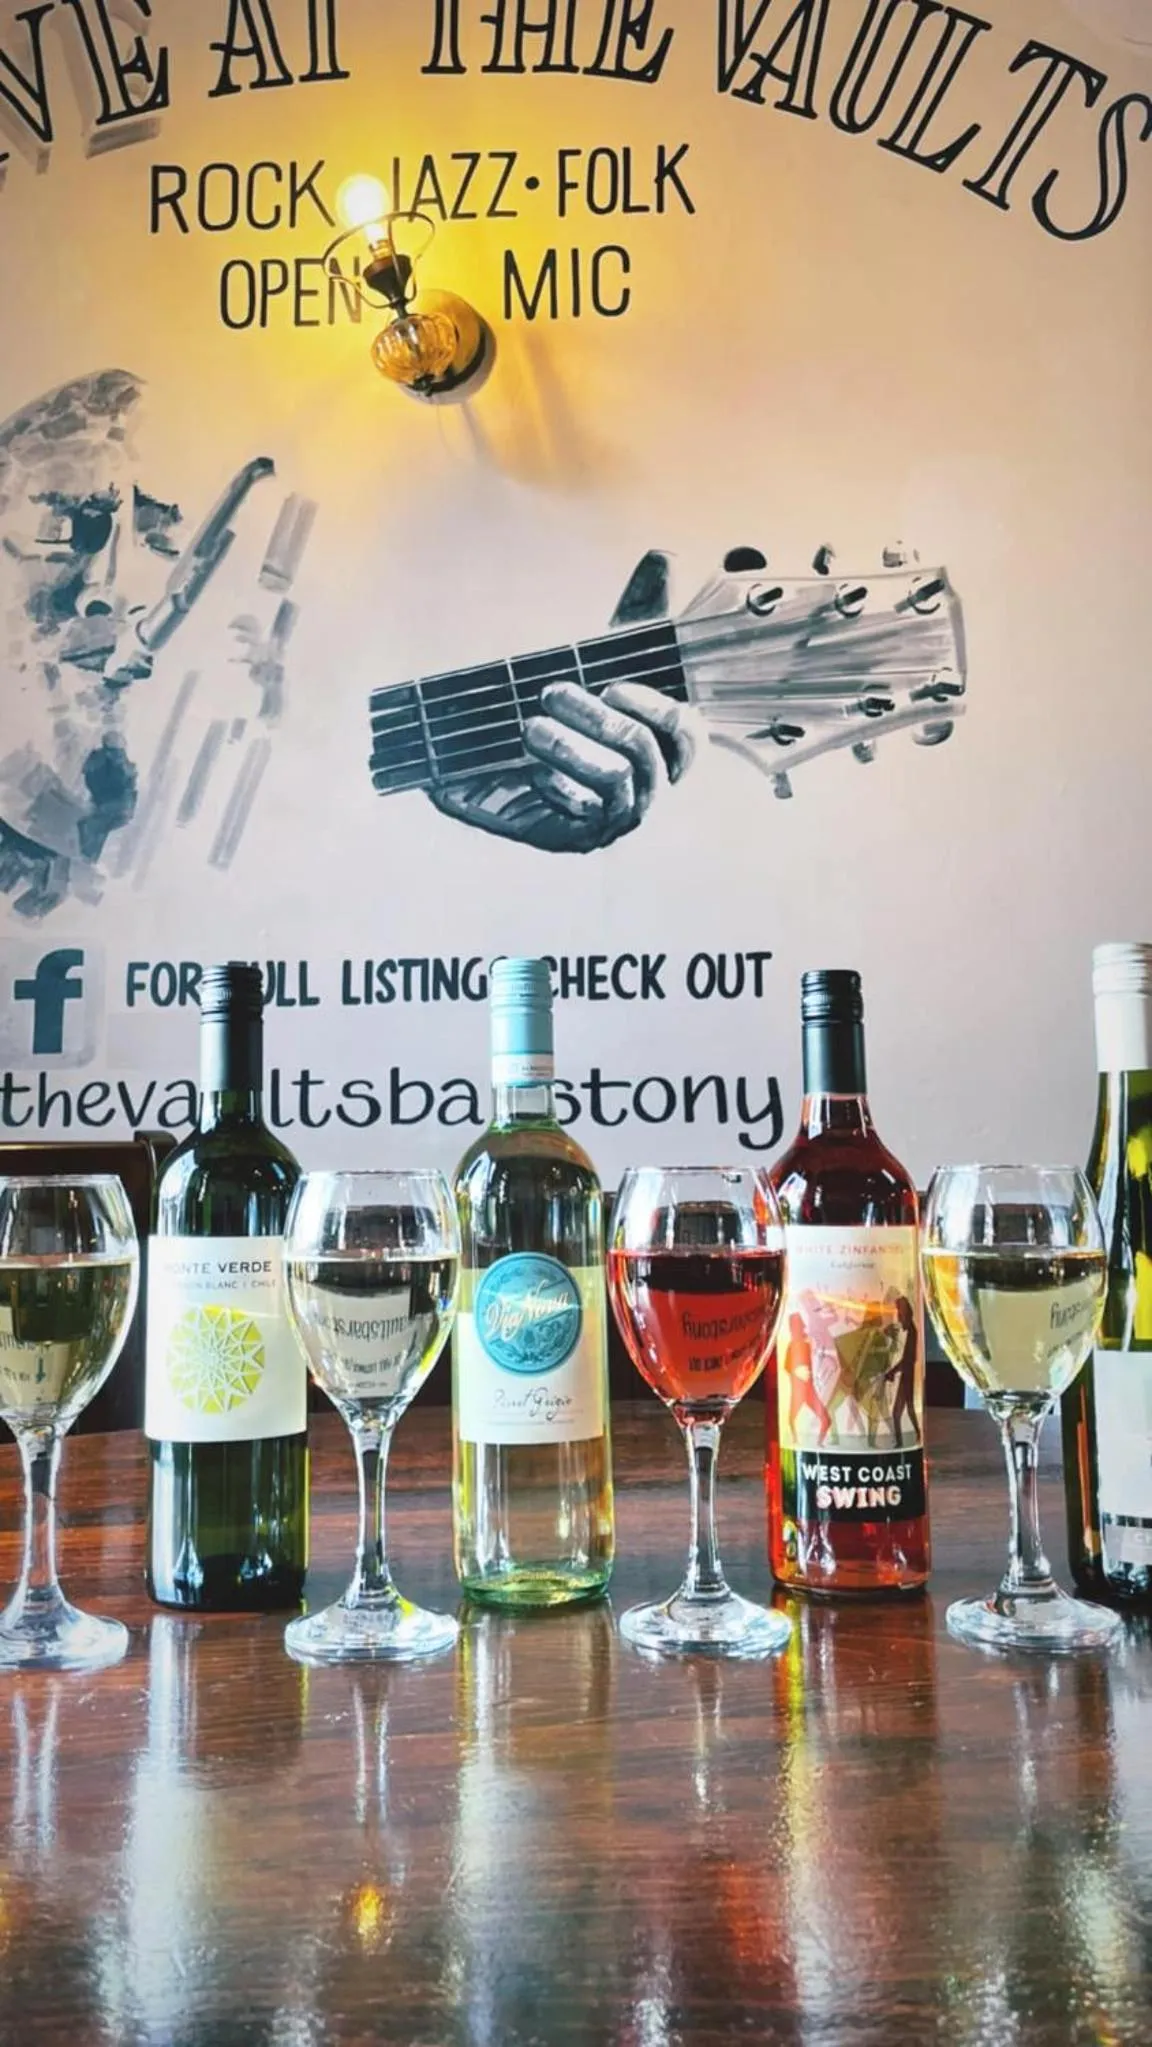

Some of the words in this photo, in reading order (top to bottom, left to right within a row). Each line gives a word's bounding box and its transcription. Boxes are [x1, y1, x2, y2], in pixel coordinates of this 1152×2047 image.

[0, 0, 169, 160] VE
[717, 0, 1152, 240] VAULTS
[150, 159, 335, 234] ROCK
[558, 144, 695, 217] FOLK
[220, 258, 362, 329] OPEN
[504, 245, 630, 320] MIC
[126, 961, 202, 1007] FOR
[228, 960, 320, 1007] ULL
[342, 956, 508, 1006] LISTING
[687, 951, 772, 1000] OUT
[0, 1066, 784, 1151] thevaltsbastony
[218, 1261, 272, 1274] VERDE
[802, 1463, 852, 1482] WEST
[858, 1464, 912, 1482] COAST
[816, 1485, 902, 1509] SWING
